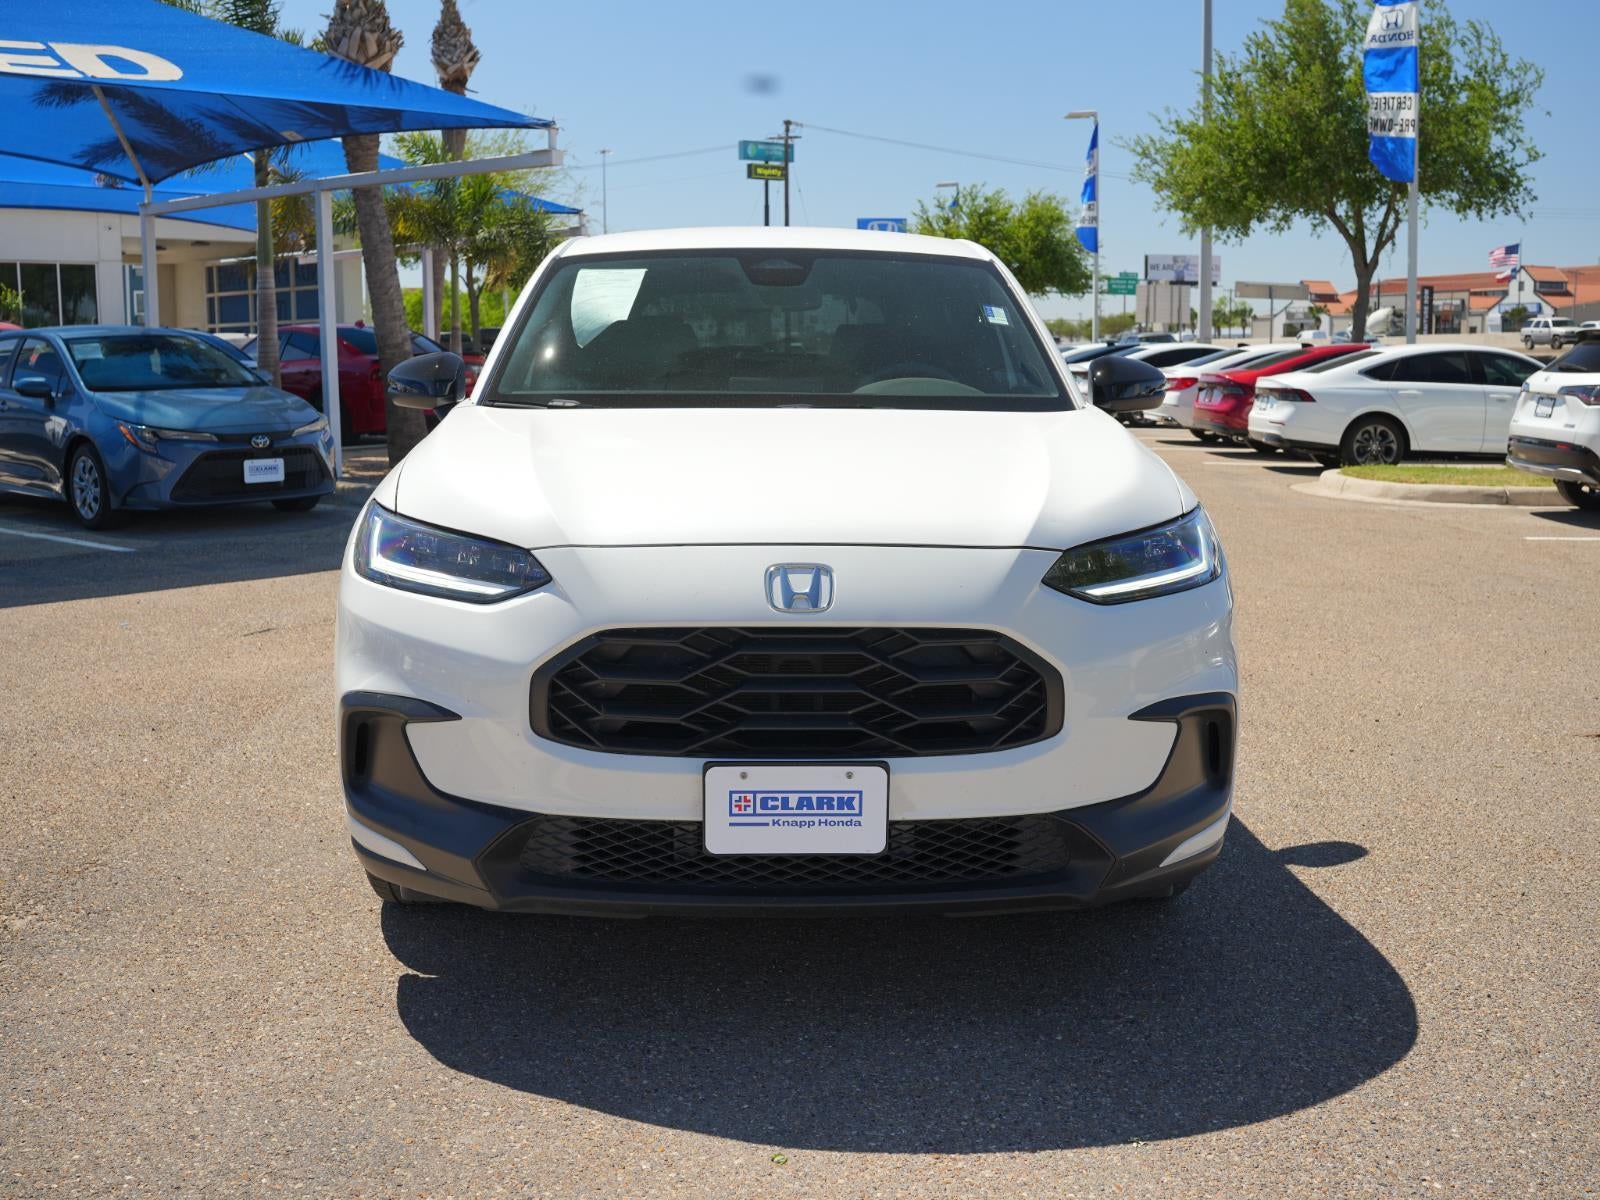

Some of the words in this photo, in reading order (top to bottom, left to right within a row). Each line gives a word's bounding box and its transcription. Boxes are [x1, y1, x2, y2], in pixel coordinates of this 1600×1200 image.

[759, 796, 856, 811] CLARK
[771, 818, 816, 829] Knapp
[818, 818, 862, 828] Honda
